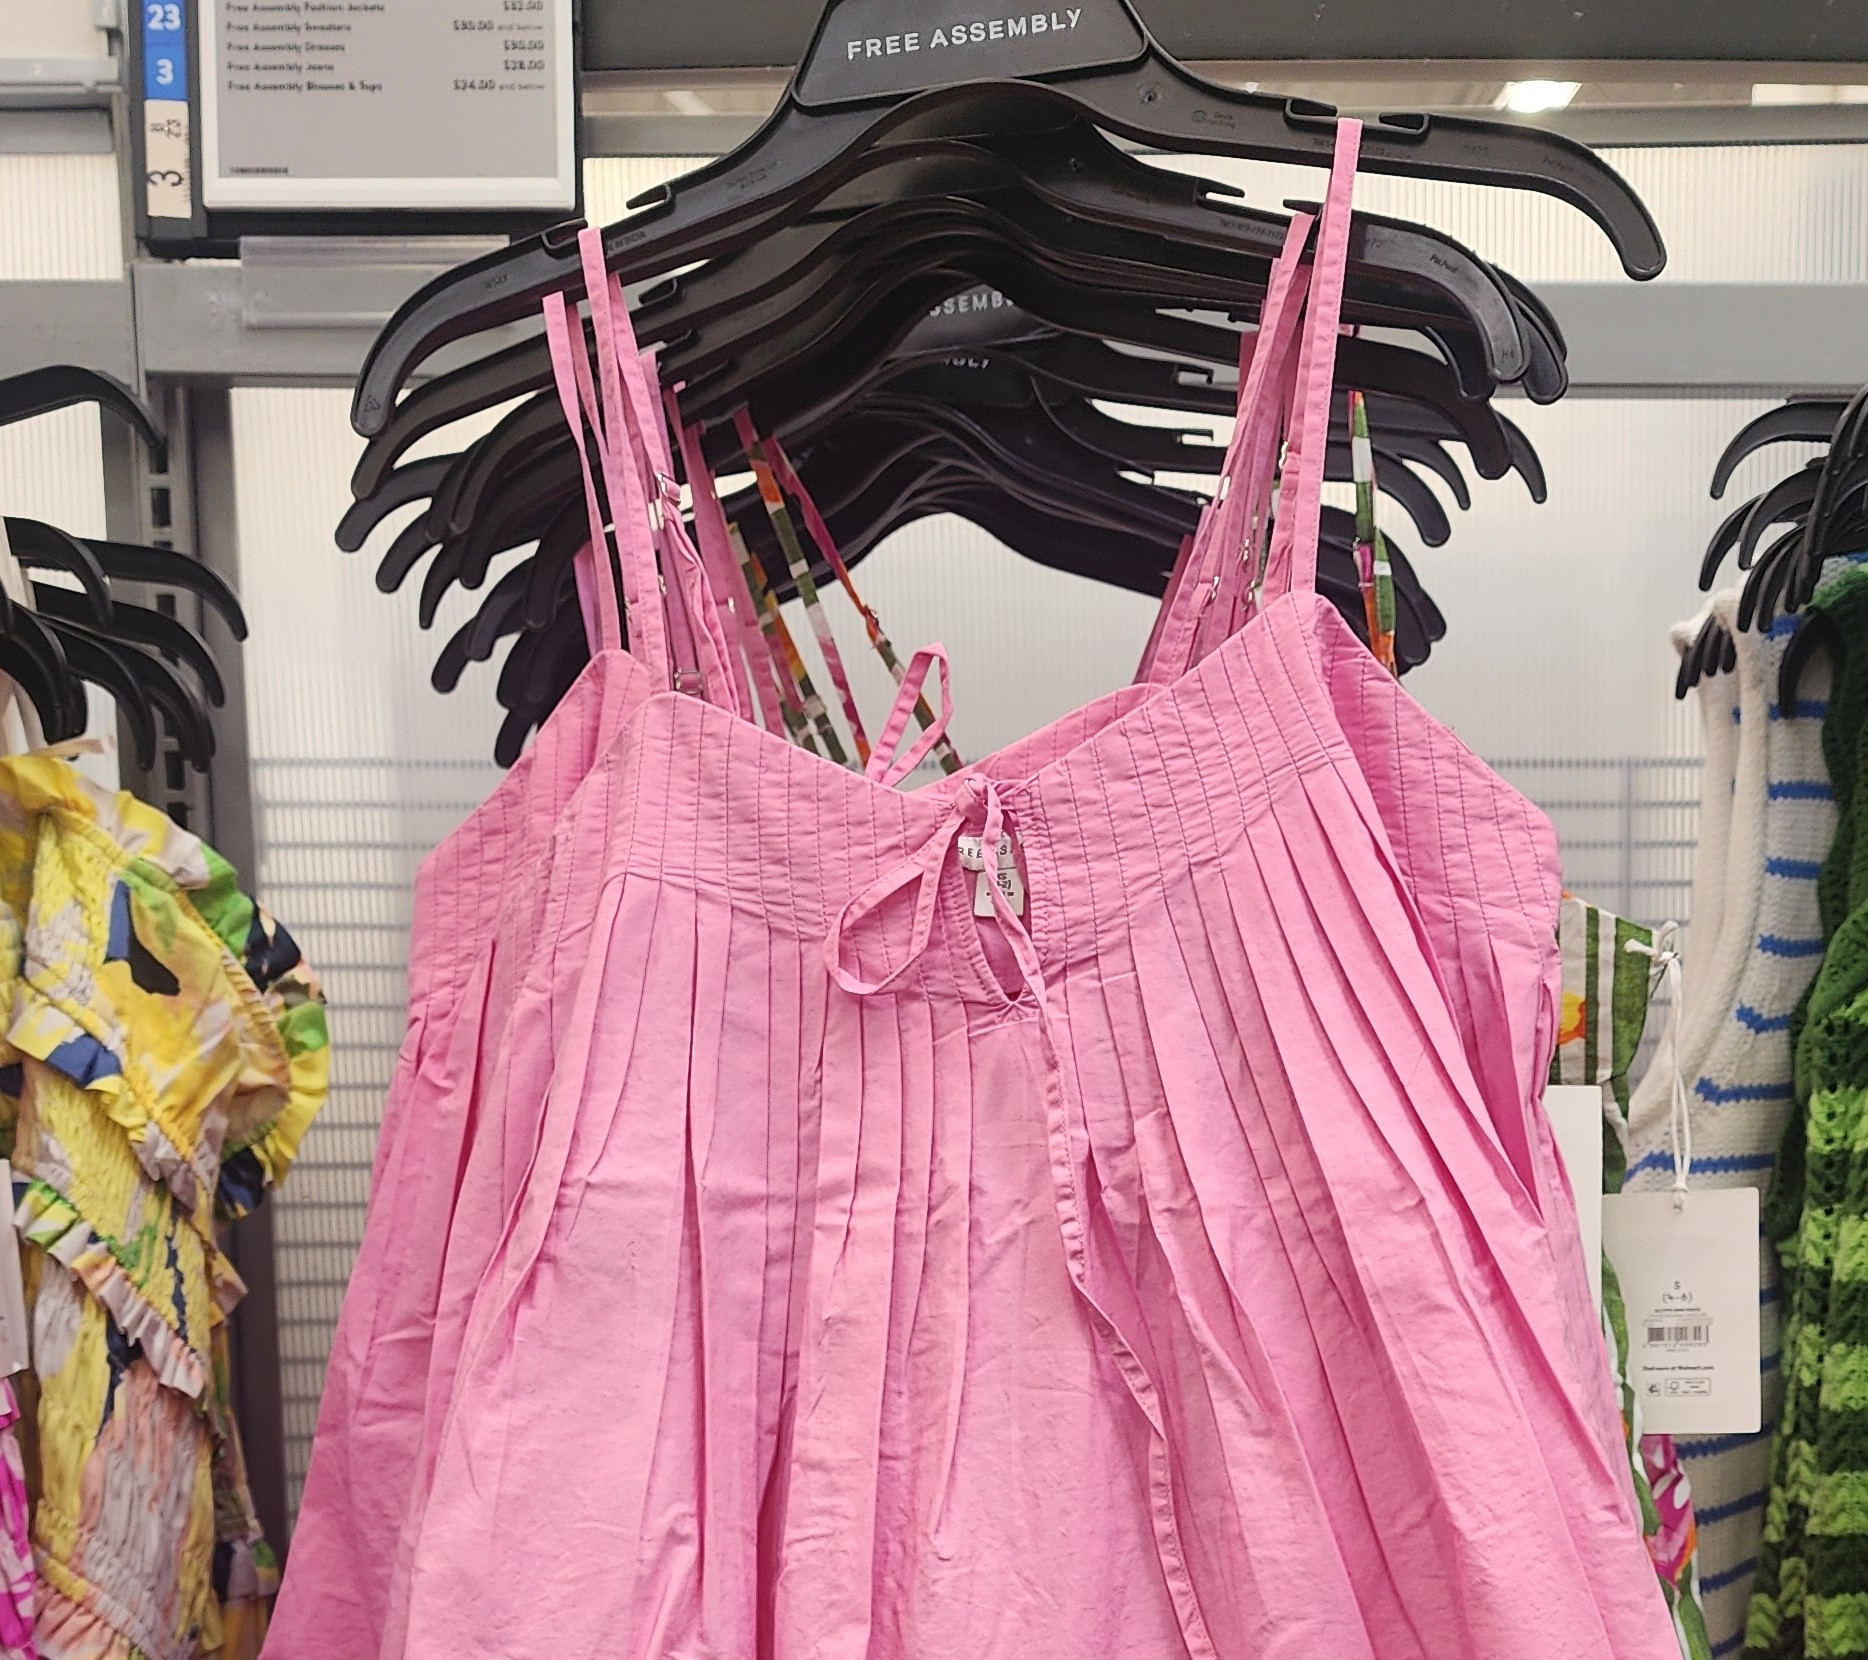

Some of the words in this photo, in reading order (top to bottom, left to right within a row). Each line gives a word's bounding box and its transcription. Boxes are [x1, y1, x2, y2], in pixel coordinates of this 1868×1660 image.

[147, 4, 181, 31] 23
[847, 33, 920, 60] FREE
[930, 8, 1082, 49] ASSEMBLY
[156, 58, 173, 86] 3
[958, 847, 982, 859] REE
